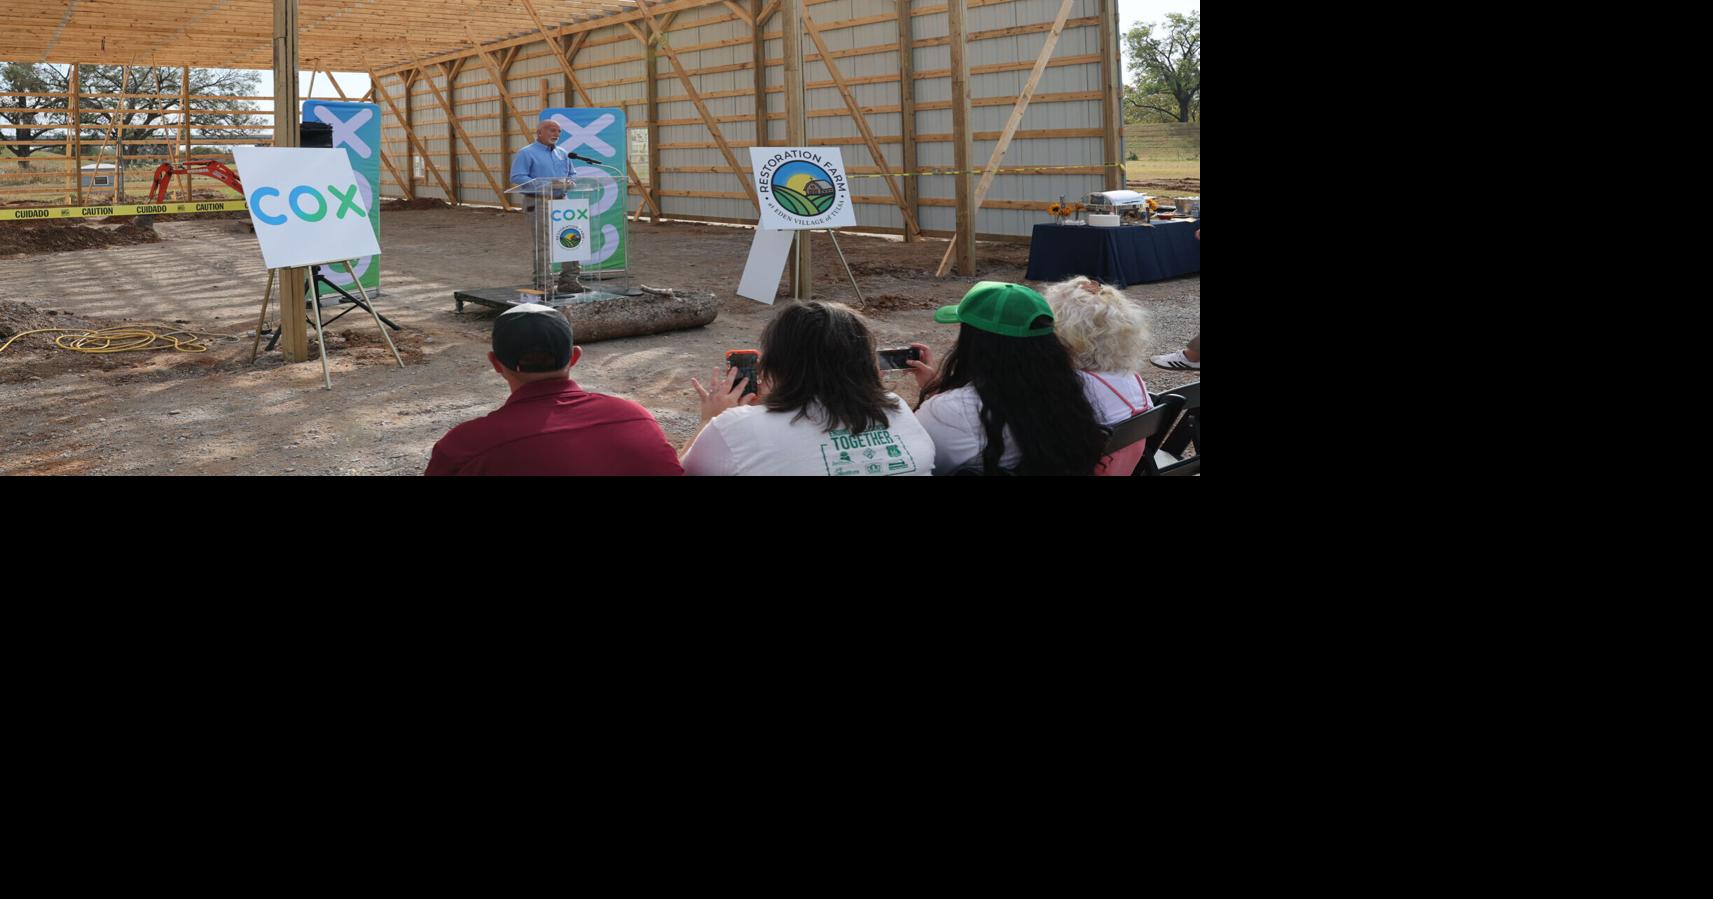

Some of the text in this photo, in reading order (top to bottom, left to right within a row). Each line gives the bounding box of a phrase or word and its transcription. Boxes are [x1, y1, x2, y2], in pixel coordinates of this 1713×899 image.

[760, 150, 847, 193] RESTORATION FARM
[15, 209, 49, 219] CUIDADO
[81, 207, 114, 216] CAUTION
[136, 205, 167, 214] CUIDADO
[195, 203, 225, 211] CAUTION
[250, 184, 366, 225] COX
[551, 208, 588, 221] COX
[774, 208, 793, 222] EDEN
[794, 218, 825, 226] VILLAGE
[831, 430, 894, 450] TOGETHER
